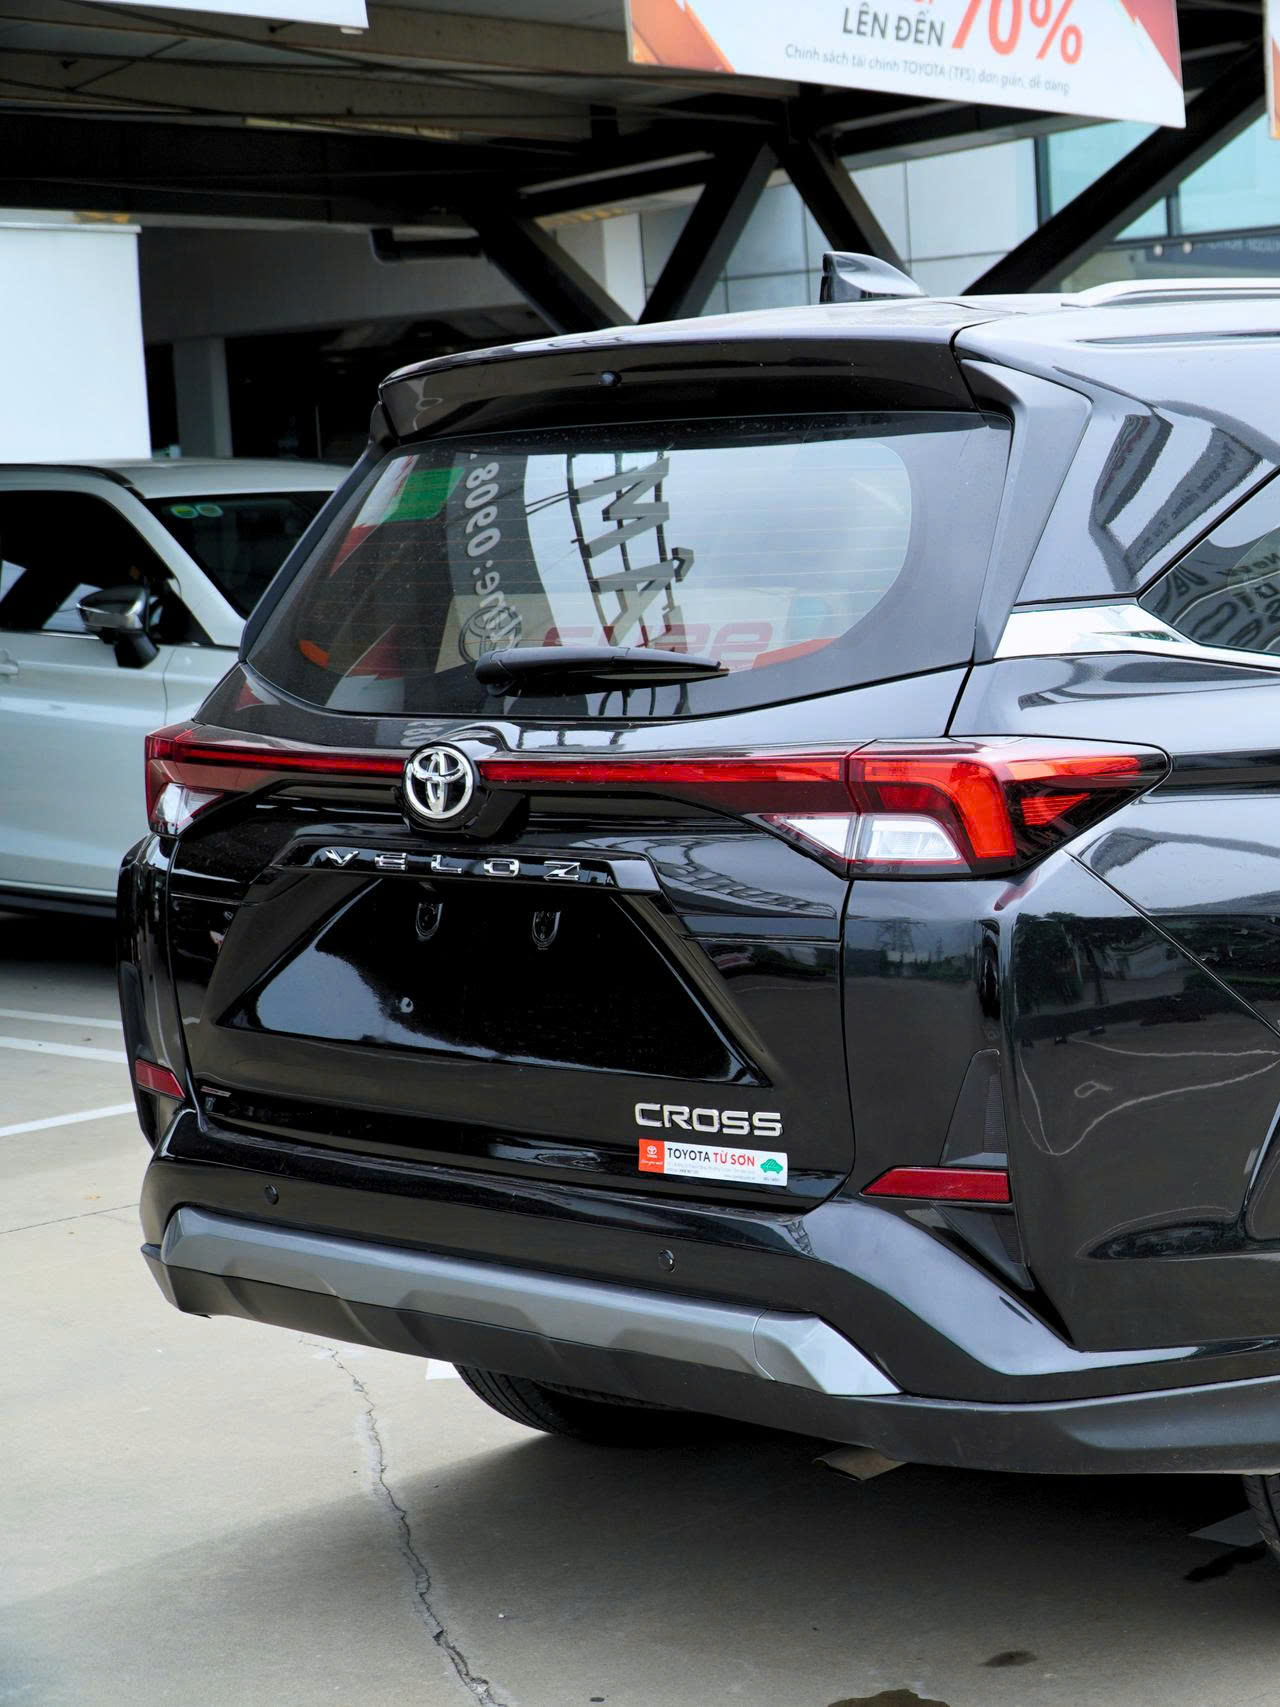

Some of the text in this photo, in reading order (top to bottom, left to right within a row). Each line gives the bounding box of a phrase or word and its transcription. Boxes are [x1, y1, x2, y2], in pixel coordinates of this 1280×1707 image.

[842, 0, 1084, 64] LÊN ĐẾN 70%
[902, 60, 946, 77] TOYOTA
[325, 849, 582, 881] VELOZ
[634, 1102, 784, 1137] CROSS
[667, 1147, 711, 1163] TOYOTA
[731, 1152, 756, 1167] SƠN
